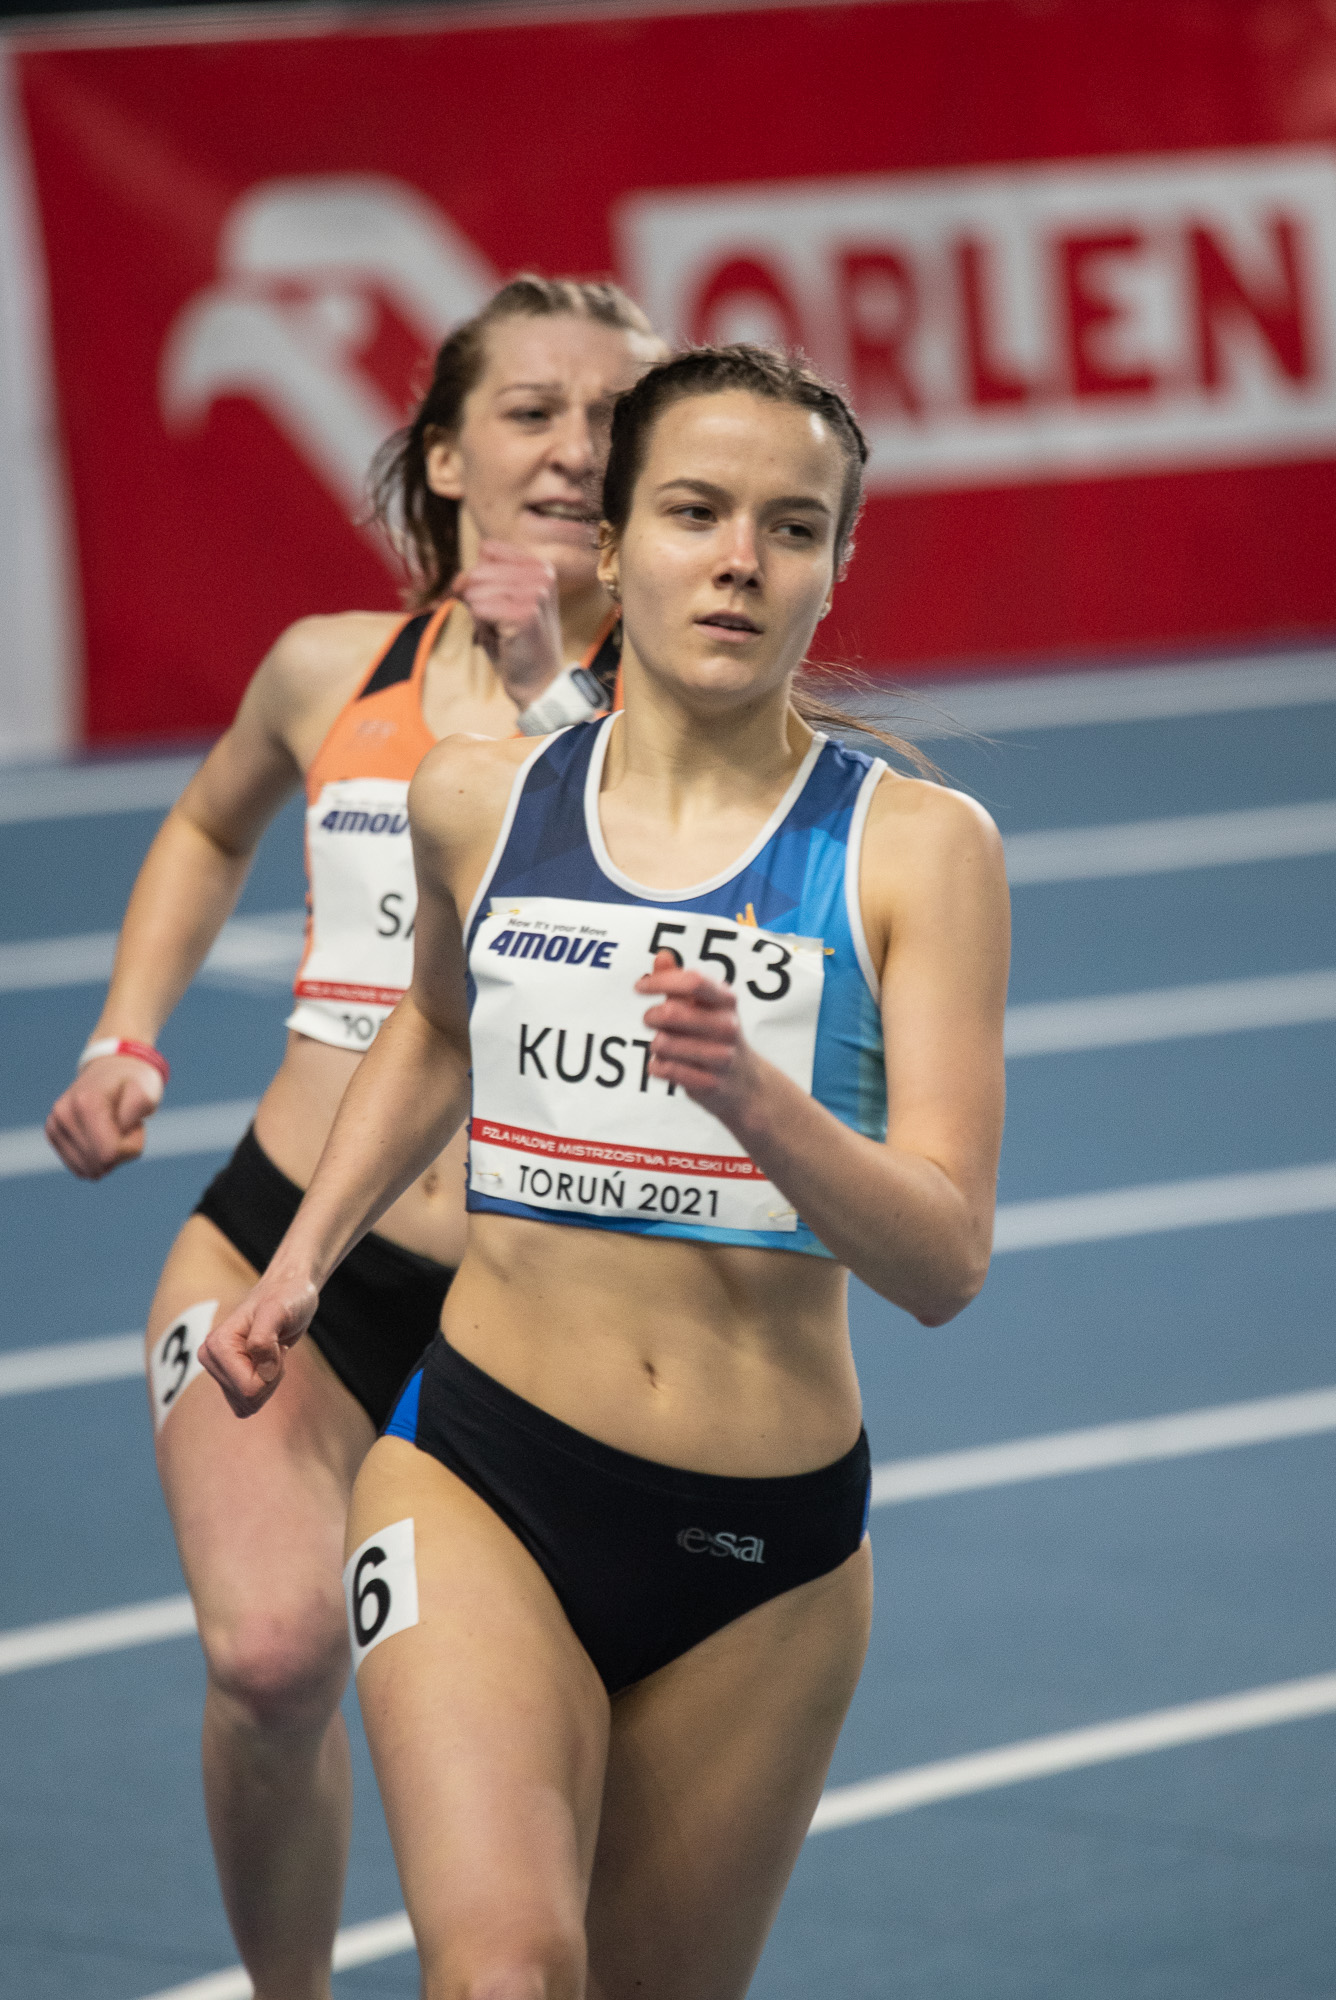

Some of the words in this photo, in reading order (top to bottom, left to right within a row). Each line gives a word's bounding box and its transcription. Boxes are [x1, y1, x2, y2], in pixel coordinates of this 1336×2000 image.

[686, 204, 1310, 430] ORLEN
[321, 810, 409, 835] 4MOV
[488, 930, 620, 970] 4MOVE
[552, 923, 578, 934] your
[580, 925, 608, 937] Move
[648, 922, 793, 1002] 553
[519, 1023, 676, 1097] KUST
[511, 1132, 555, 1153] HALOWE
[557, 1144, 666, 1167] MISTRZOSTWA
[667, 1156, 722, 1173] POLSKI
[724, 1161, 752, 1175] U18
[519, 1165, 625, 1209] TORUŃ
[638, 1182, 719, 1218] 2021
[161, 1324, 190, 1405] 3
[352, 1546, 392, 1649] 6
